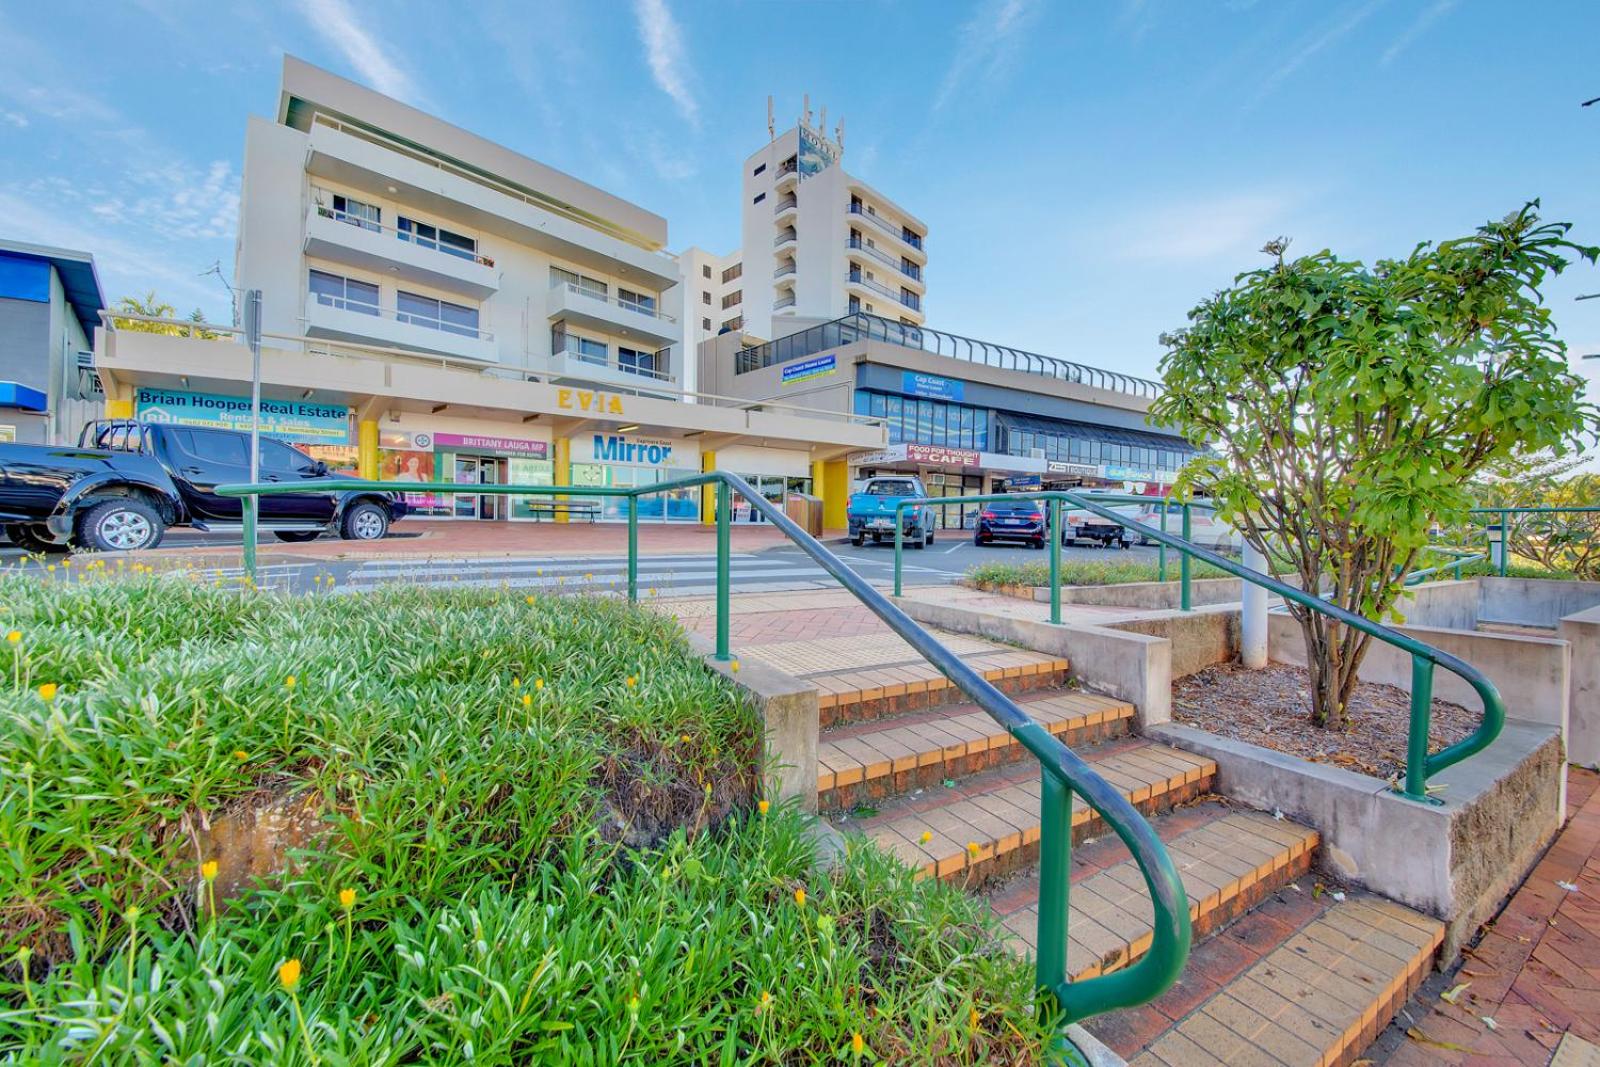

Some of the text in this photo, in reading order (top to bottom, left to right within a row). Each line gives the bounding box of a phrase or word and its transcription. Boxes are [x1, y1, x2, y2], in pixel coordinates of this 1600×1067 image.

[140, 392, 346, 418] Brian Hooper Real Estate
[463, 437, 502, 448] BRITTANY
[504, 440, 529, 450] LAUGA
[594, 435, 672, 464] Mirror
[908, 445, 930, 453] FOOD
[947, 449, 978, 458] THOUGHT
[929, 453, 975, 465] CAFE
